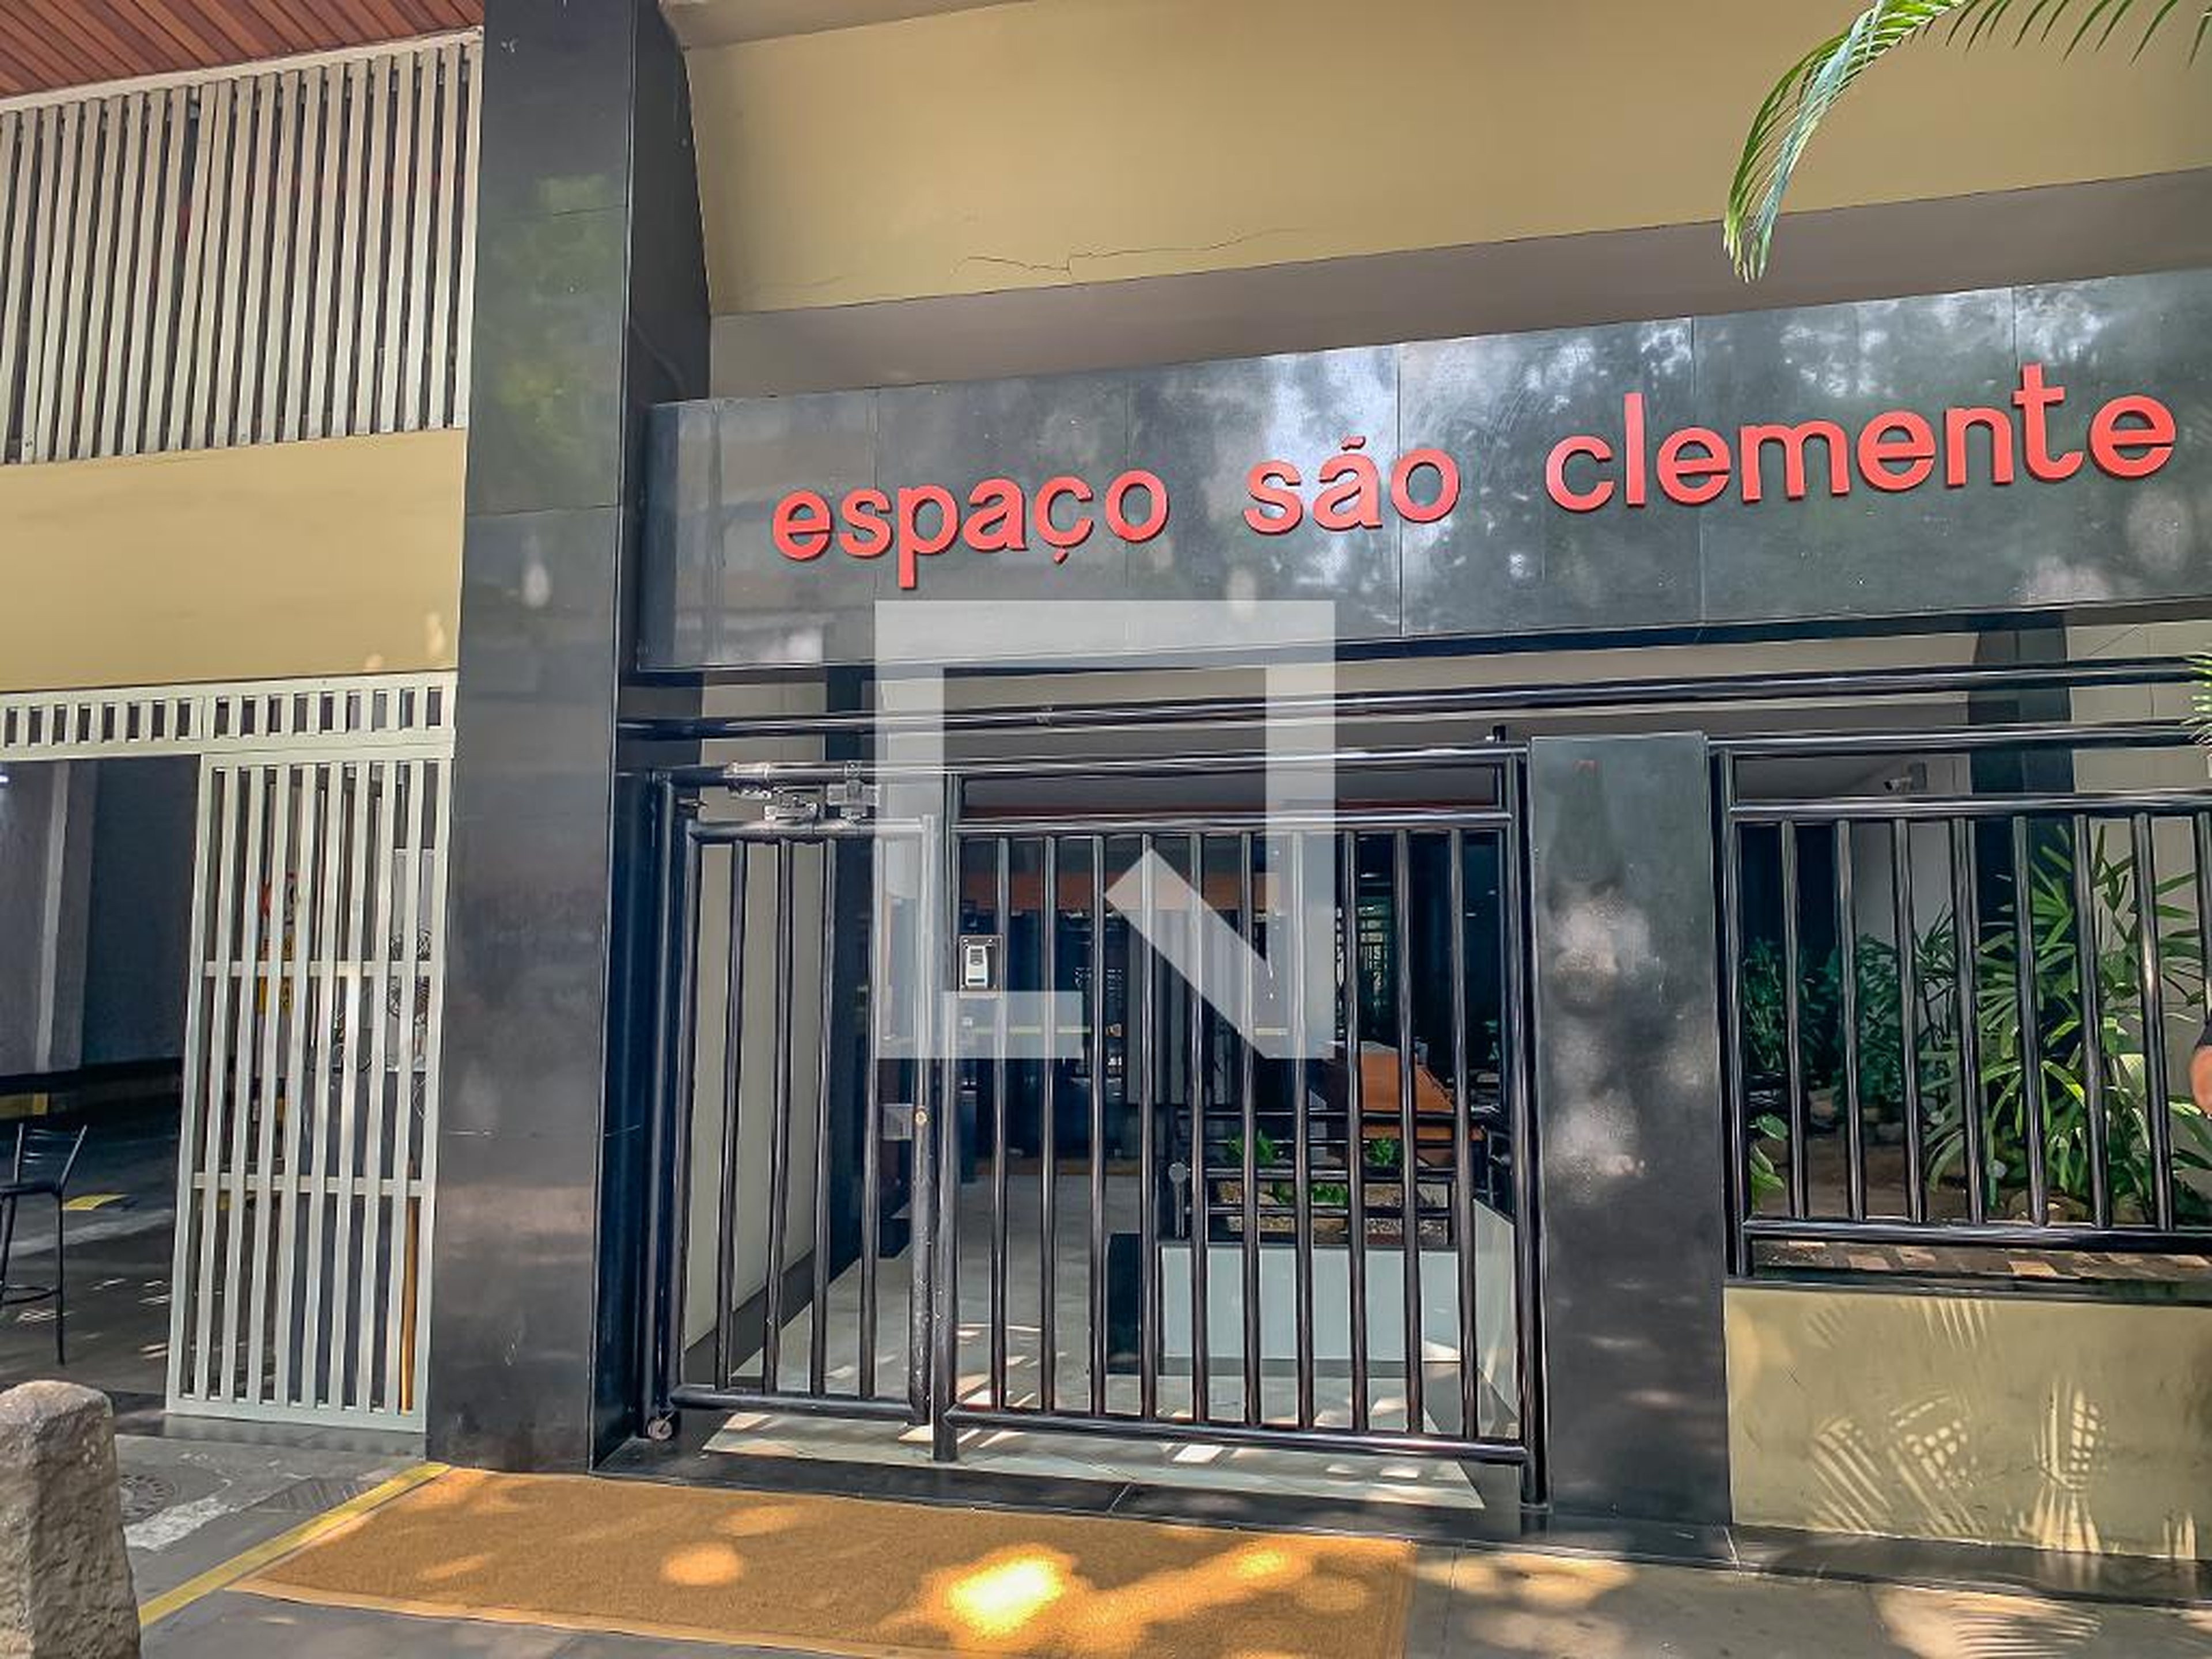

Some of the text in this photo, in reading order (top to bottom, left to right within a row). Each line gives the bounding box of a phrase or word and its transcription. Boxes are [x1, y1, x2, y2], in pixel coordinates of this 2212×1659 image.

[771, 364, 2177, 589] espaço são clemente
